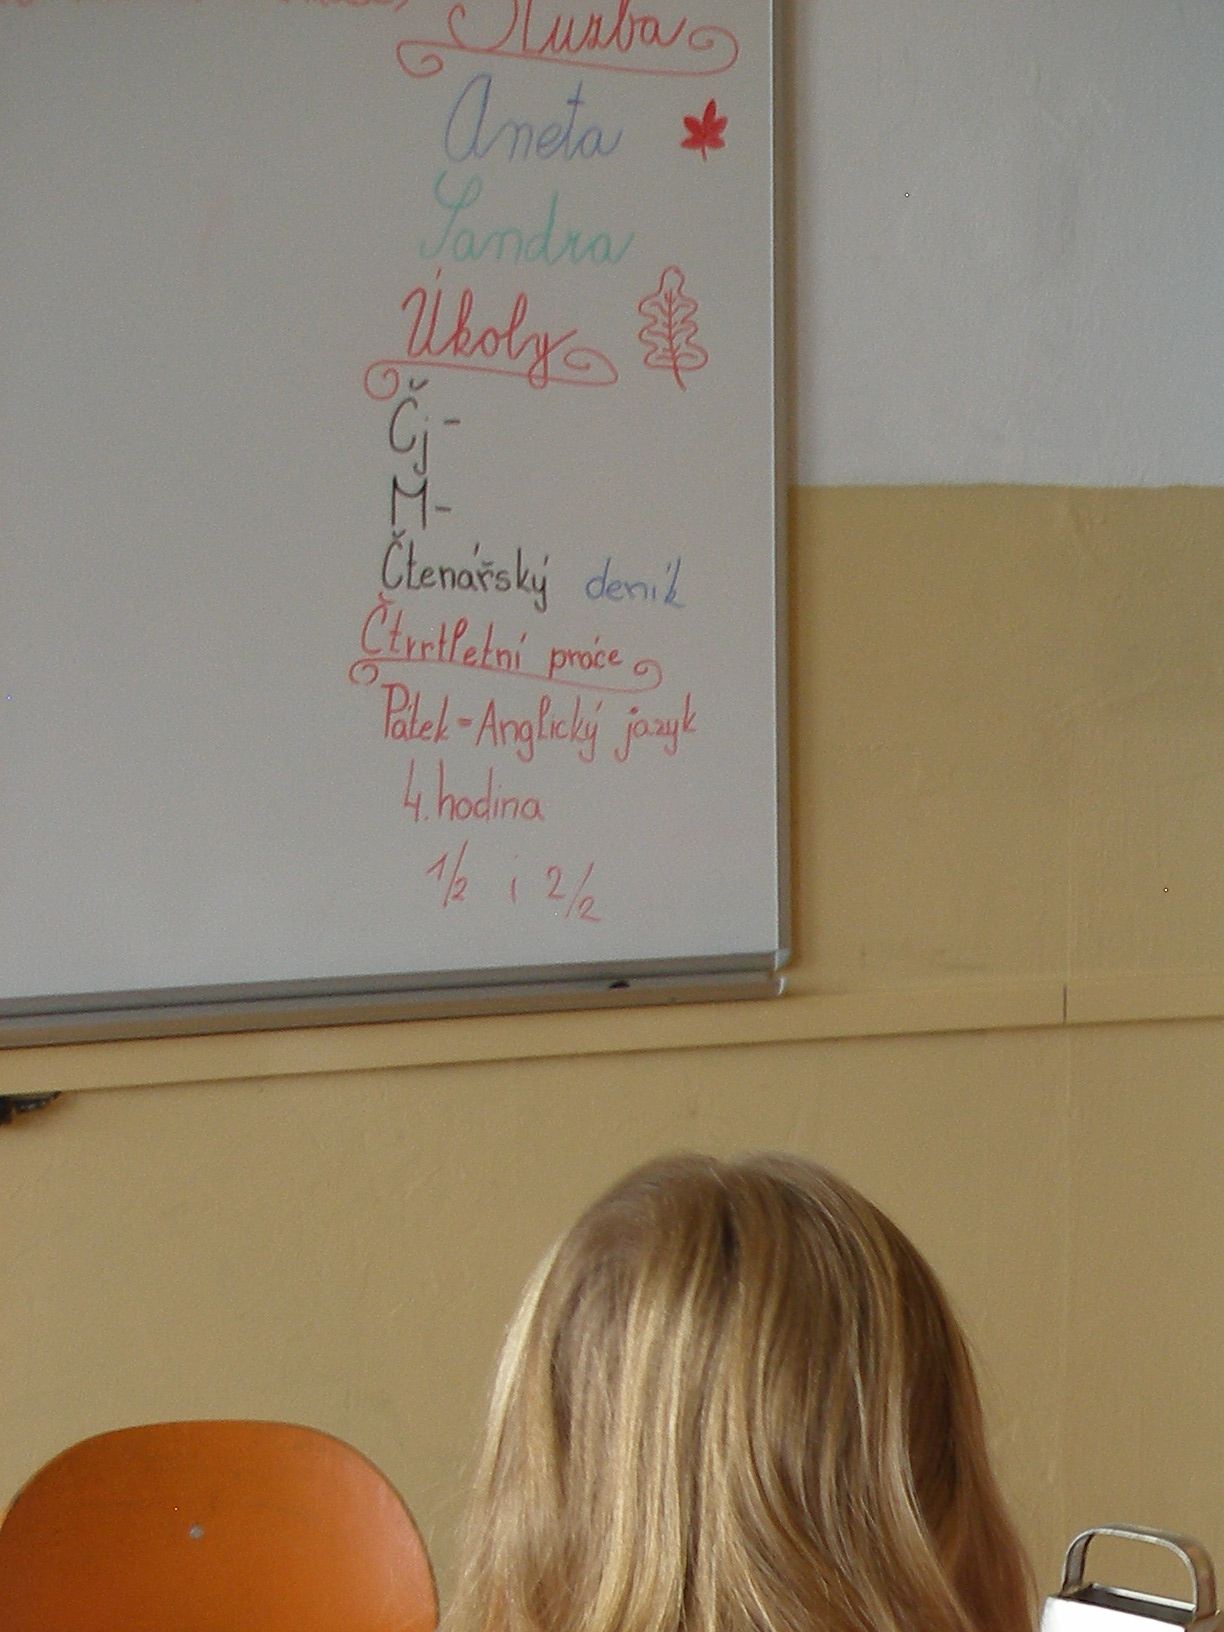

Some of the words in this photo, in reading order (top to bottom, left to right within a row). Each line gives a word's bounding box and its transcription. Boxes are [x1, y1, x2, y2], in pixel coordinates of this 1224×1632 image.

[443, 72, 623, 160] Aneta
[419, 171, 635, 266] Sandra
[402, 268, 577, 390] Úkoly
[381, 529, 549, 613] Čtenářský
[585, 556, 685, 608] deník
[548, 635, 624, 679] práce
[614, 692, 698, 763] jazyk
